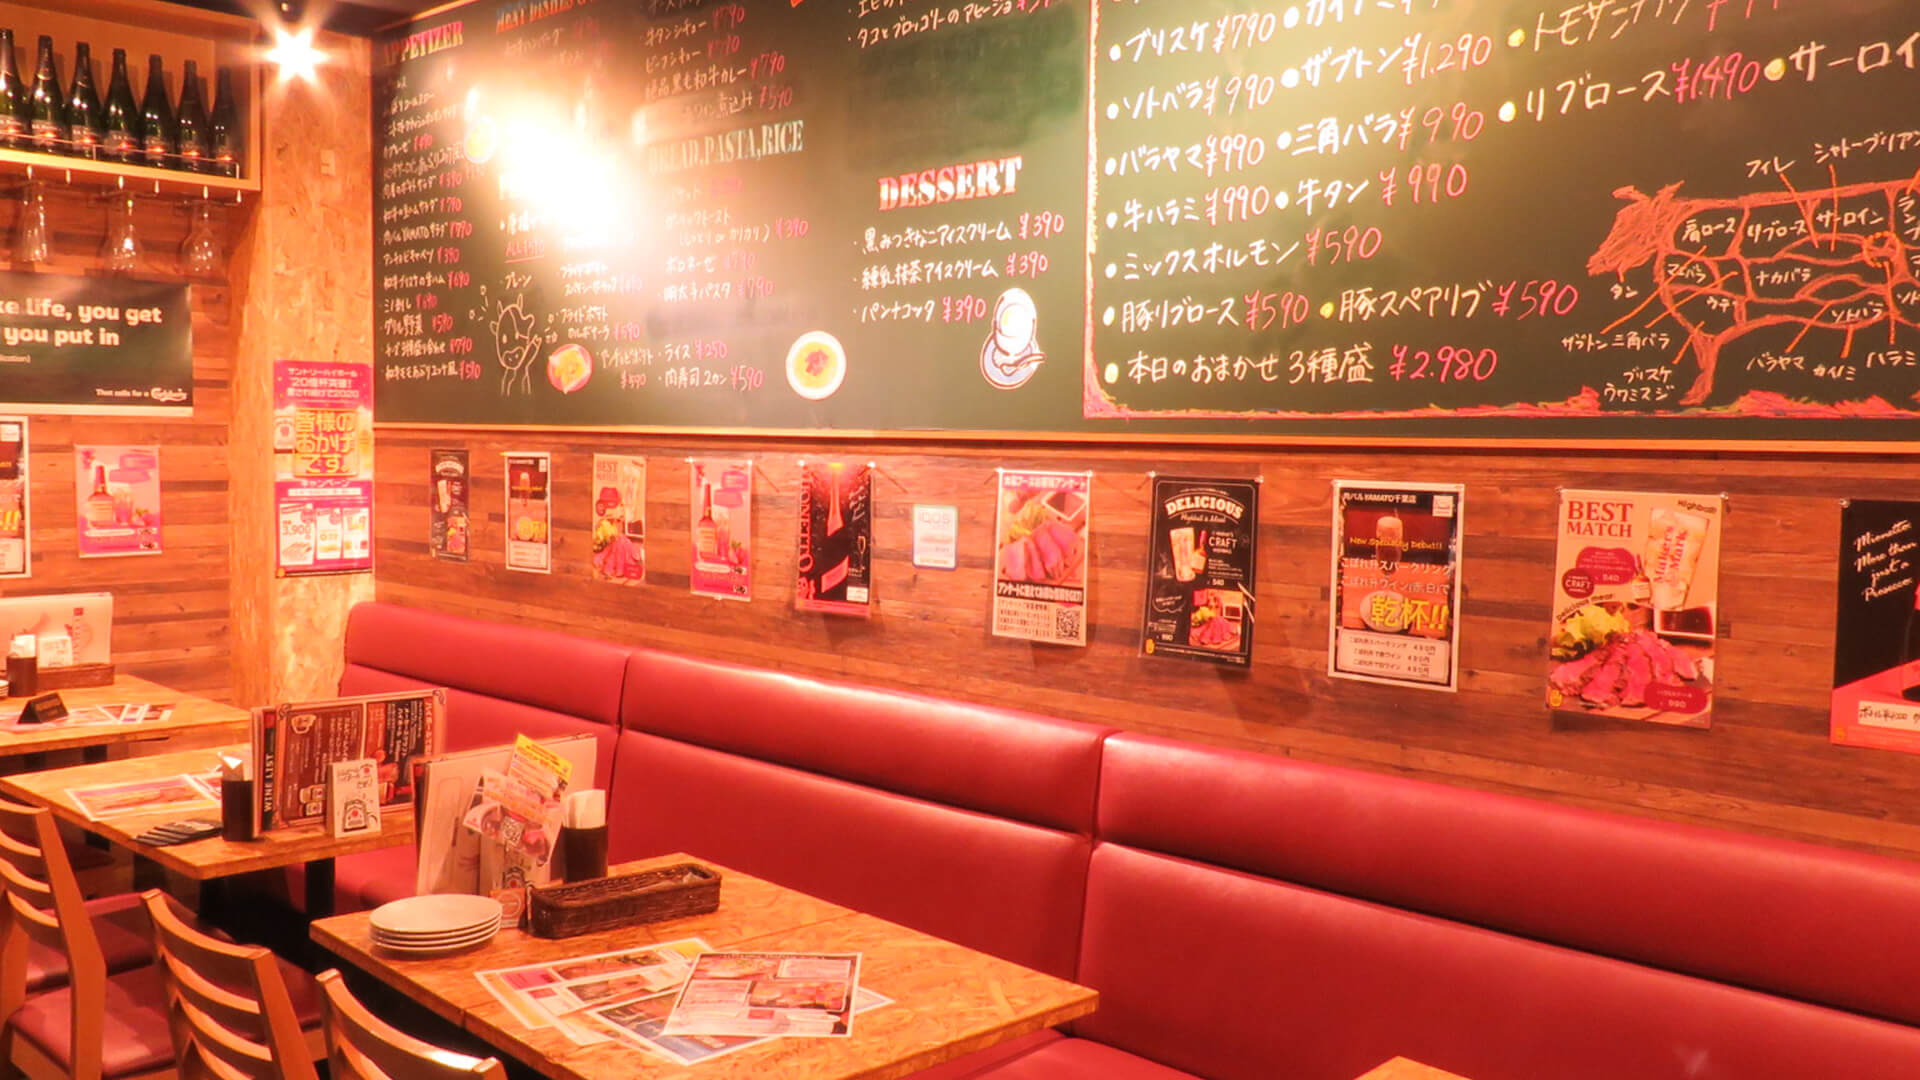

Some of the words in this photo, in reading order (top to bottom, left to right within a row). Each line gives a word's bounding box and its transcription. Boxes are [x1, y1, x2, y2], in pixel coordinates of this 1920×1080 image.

[1125, 20, 1209, 62] ブリスケ
[1212, 13, 1276, 54] ¥790
[1301, 46, 1402, 87] ザブトン
[1123, 81, 1203, 119] ソトバラ
[1203, 75, 1275, 117] ¥990
[1526, 70, 1670, 122] リブロース
[1291, 113, 1398, 156] 三角バラ
[1399, 102, 1484, 151] ¥990
[1119, 144, 1203, 176] バラヤマ
[1205, 134, 1264, 177] ¥990
[1745, 156, 1796, 178] フィレ
[878, 155, 1022, 211] DESSERT
[1296, 178, 1369, 216] 牛タン
[1379, 163, 1468, 206] ¥990
[1123, 198, 1200, 232] 牛ハラミ
[1205, 185, 1270, 227] ¥990
[1018, 211, 1065, 240] ¥390
[1682, 217, 1736, 243] 肩ロース
[1748, 219, 1807, 243] リブロース
[1123, 239, 1299, 280] ミックスホルモン
[1305, 225, 1382, 266] ¥590
[861, 259, 999, 291] 練乳抹茶アイスクリーム
[1006, 251, 1049, 279] ¥390
[1756, 268, 1811, 287] ナカバラ
[1338, 280, 1494, 323] 豚スペアリブ
[1491, 279, 1579, 320] ¥590
[1609, 284, 1639, 300] タン
[26, 298, 73, 321] life,
[78, 305, 120, 324] you
[125, 307, 163, 326] get
[861, 300, 935, 324] パンナコッタ
[942, 295, 987, 323] ¥390
[1122, 295, 1239, 334] 豚リブロース
[1243, 289, 1310, 331] ¥590
[4, 327, 48, 345] you
[55, 329, 93, 347] put
[100, 328, 120, 345] in
[1561, 334, 1608, 352] ザブトン
[1611, 331, 1671, 351] 三角バラ
[664, 343, 691, 361] ライス
[1127, 350, 1280, 385] 本日のおまかせ
[1288, 342, 1374, 384] 3種盛
[1746, 352, 1805, 372] バラヤマ
[1865, 350, 1917, 368] ハラミ
[731, 363, 766, 392] ¥590
[1623, 366, 1673, 384] ブリスケ
[296, 410, 357, 432] 皆様の
[296, 432, 353, 454] おかげ
[1165, 496, 1243, 520] DELICIOUS
[1568, 500, 1634, 522] BEST
[1209, 536, 1237, 549] CRAFT
[1567, 521, 1633, 538] MATCH
[1564, 579, 1591, 590] CRAFT
[1371, 592, 1450, 632] 乾杯!!
[263, 783, 273, 813] WINE
